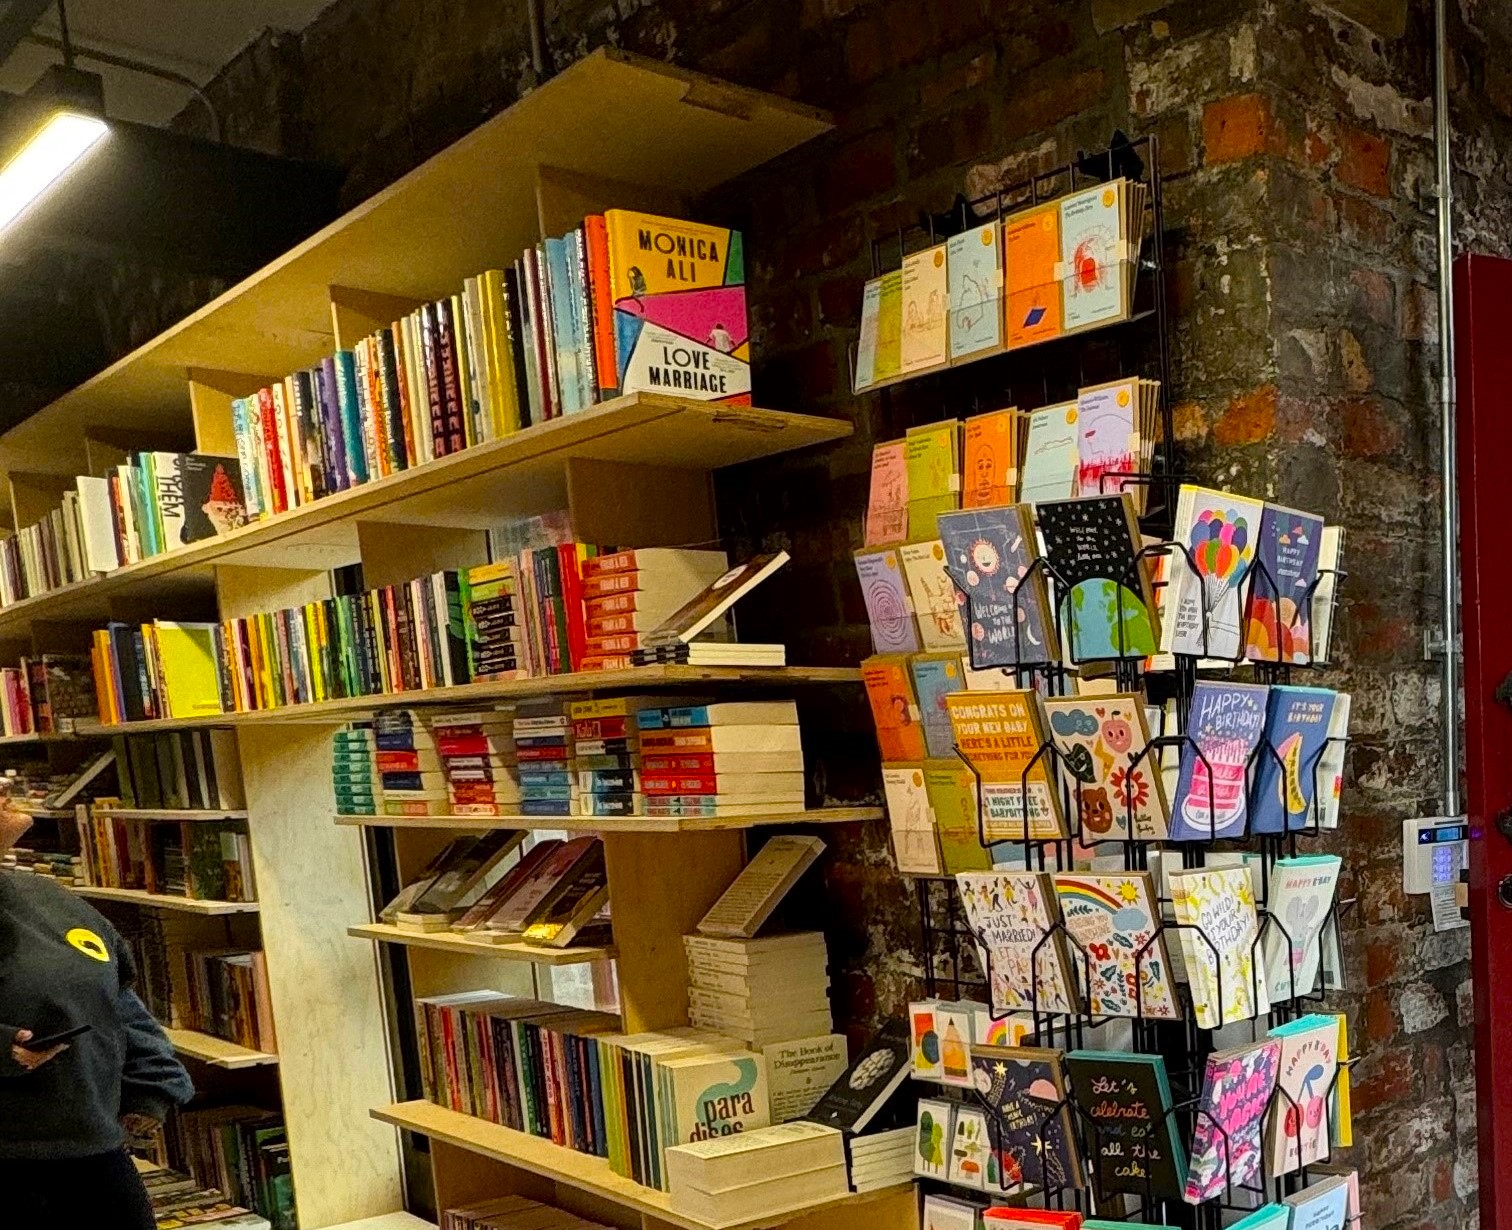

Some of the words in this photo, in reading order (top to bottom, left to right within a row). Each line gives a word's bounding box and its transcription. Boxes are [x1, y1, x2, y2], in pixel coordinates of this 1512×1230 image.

[638, 229, 720, 263] MONICA
[666, 258, 697, 283] ALI
[663, 346, 711, 371] LOVE
[648, 366, 728, 394] MARRIAGE
[157, 476, 182, 518] THEM
[951, 704, 1007, 719] CONGRATS
[1008, 702, 1026, 717] ON
[1199, 692, 1250, 728] HAPPY
[955, 722, 981, 735] YOUR
[982, 721, 1002, 734] NEW
[1003, 720, 1028, 733] BABY
[1001, 736, 1034, 747] LITTLE
[1016, 796, 1038, 806] FEE
[983, 914, 1012, 929] JUST
[779, 1048, 798, 1059] The
[800, 1046, 823, 1057] Book
[824, 1042, 835, 1052] of
[1286, 1041, 1313, 1077] HAPPY
[774, 1053, 841, 1070] Disappearance
[1091, 1076, 1138, 1095] Let's
[703, 1091, 756, 1127] para
[1090, 1100, 1150, 1120] celebrate
[1100, 1142, 1125, 1156] all
